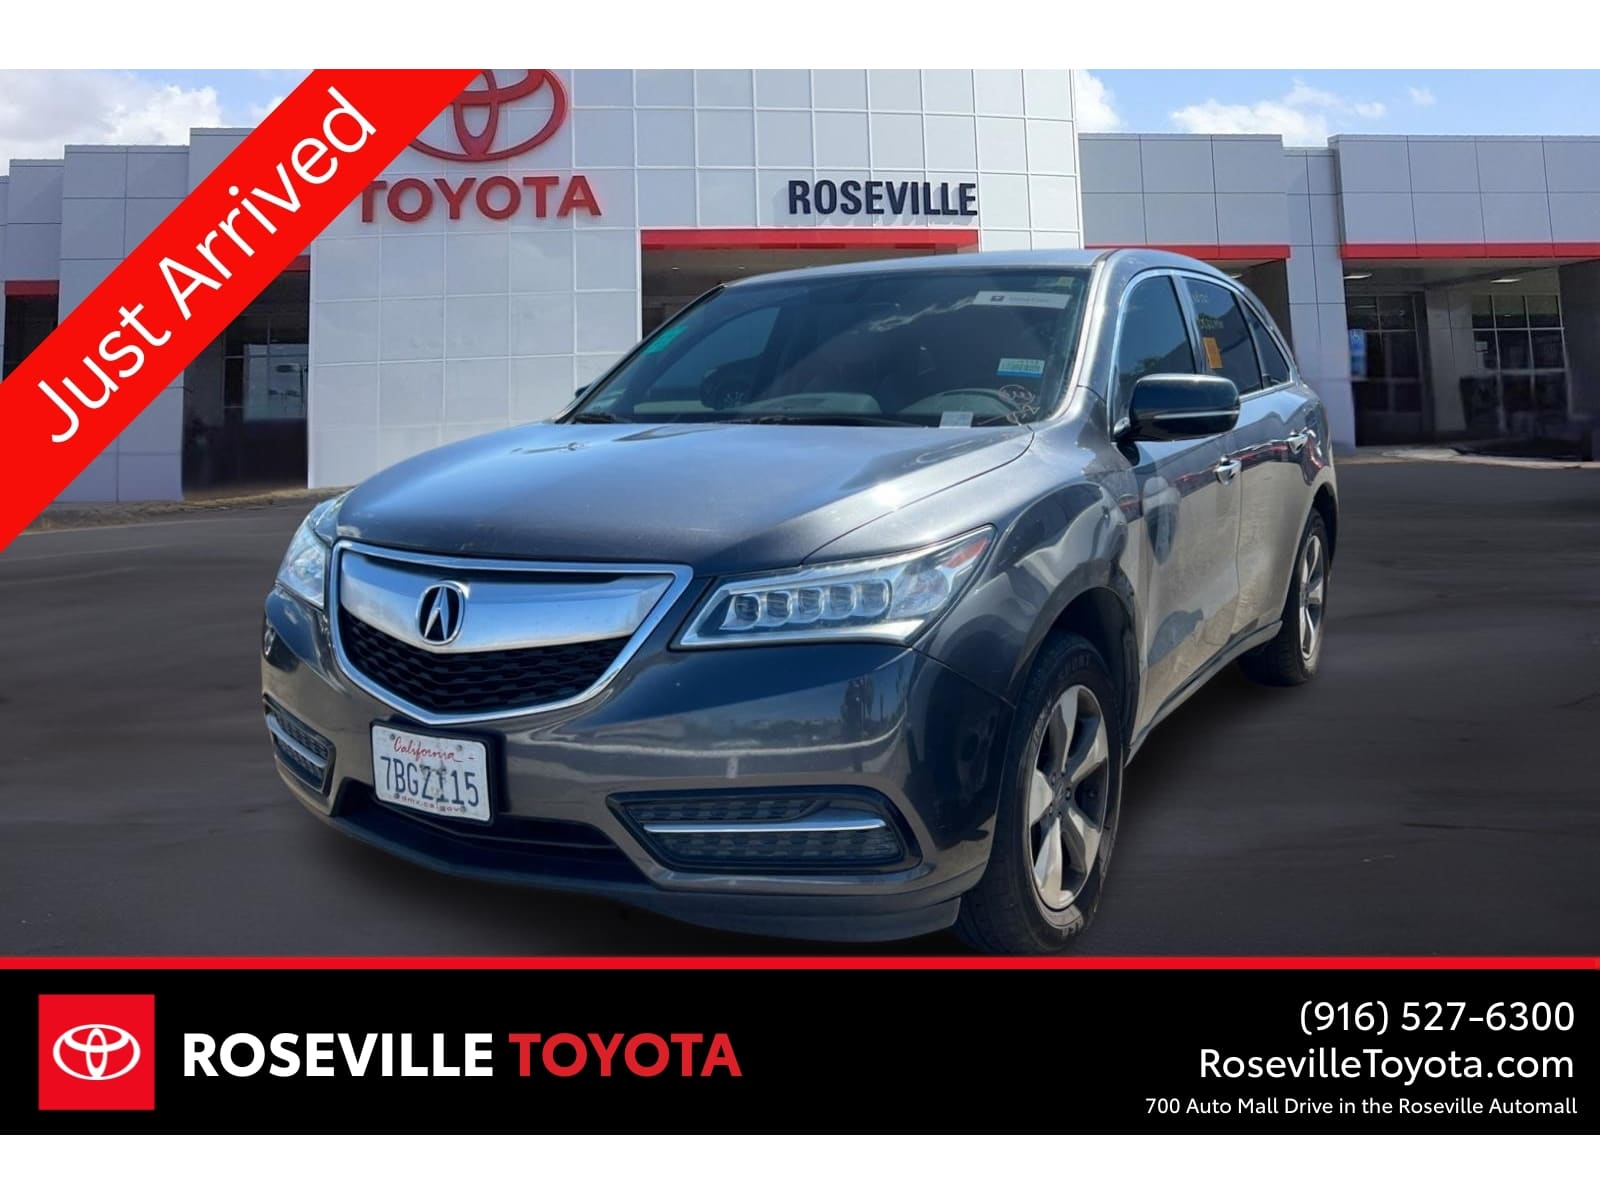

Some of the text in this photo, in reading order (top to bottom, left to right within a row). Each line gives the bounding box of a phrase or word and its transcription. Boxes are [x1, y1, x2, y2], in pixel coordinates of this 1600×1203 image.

[361, 175, 602, 222] TOYOTA
[788, 180, 978, 216] ROSEVILLE
[393, 736, 462, 762] California
[380, 755, 480, 807] 7BGZ115
